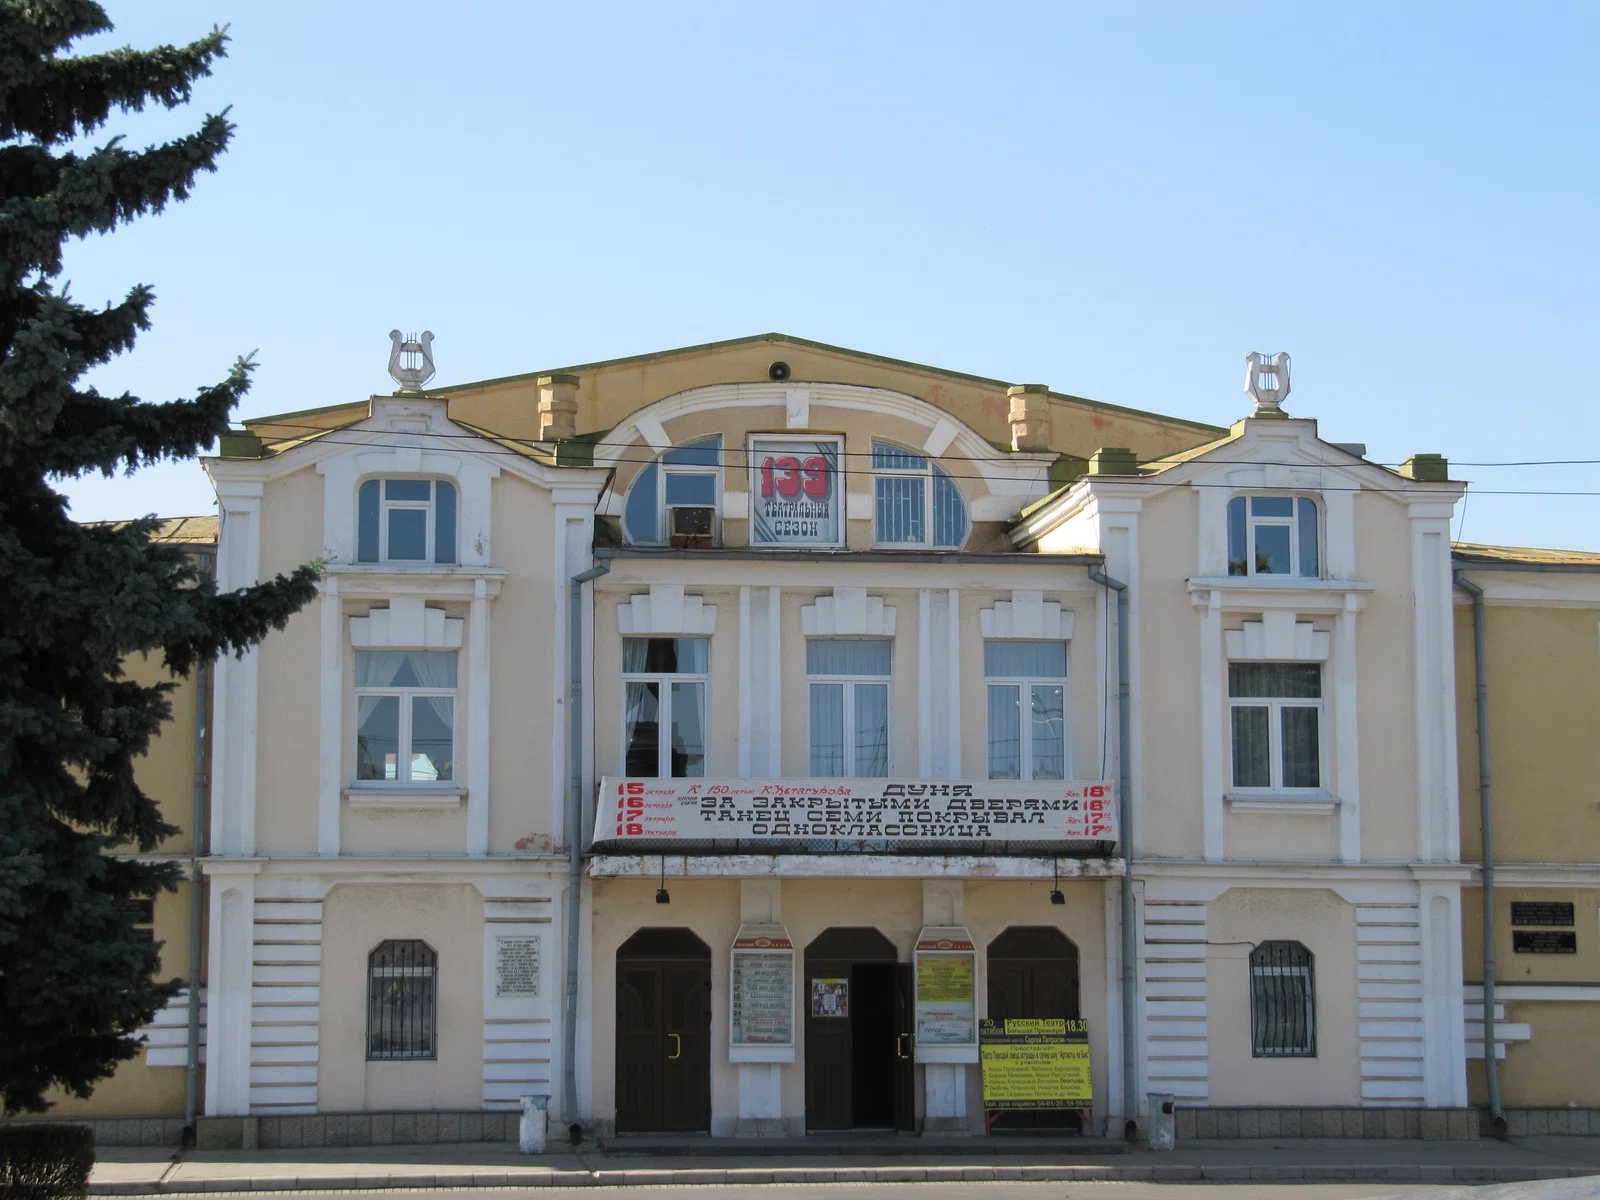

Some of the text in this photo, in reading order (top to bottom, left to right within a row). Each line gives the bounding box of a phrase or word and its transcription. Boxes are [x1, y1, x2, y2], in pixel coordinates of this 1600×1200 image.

[761, 456, 830, 499] 139
[765, 501, 829, 519] ТЕАТРАЛЬНЫЙ
[775, 521, 818, 536] СЕЗОН
[618, 783, 644, 795] 15
[883, 784, 972, 797] ДУНЯ
[618, 797, 644, 808] 16
[701, 797, 735, 808] ЗА
[753, 797, 929, 809] ЗАКРЫТЫМИ
[947, 799, 1078, 810] ДВЕРЯМИ
[617, 810, 643, 822] 17
[701, 810, 790, 822] ТАНЕЦ
[807, 811, 881, 822] СЕМИ
[899, 811, 1044, 823] ПОКРЫВАЛ
[617, 824, 643, 835] 18
[753, 824, 991, 837] ОДНОКЛАССНИЦА
[1066, 1019, 1088, 1032] 18.30
